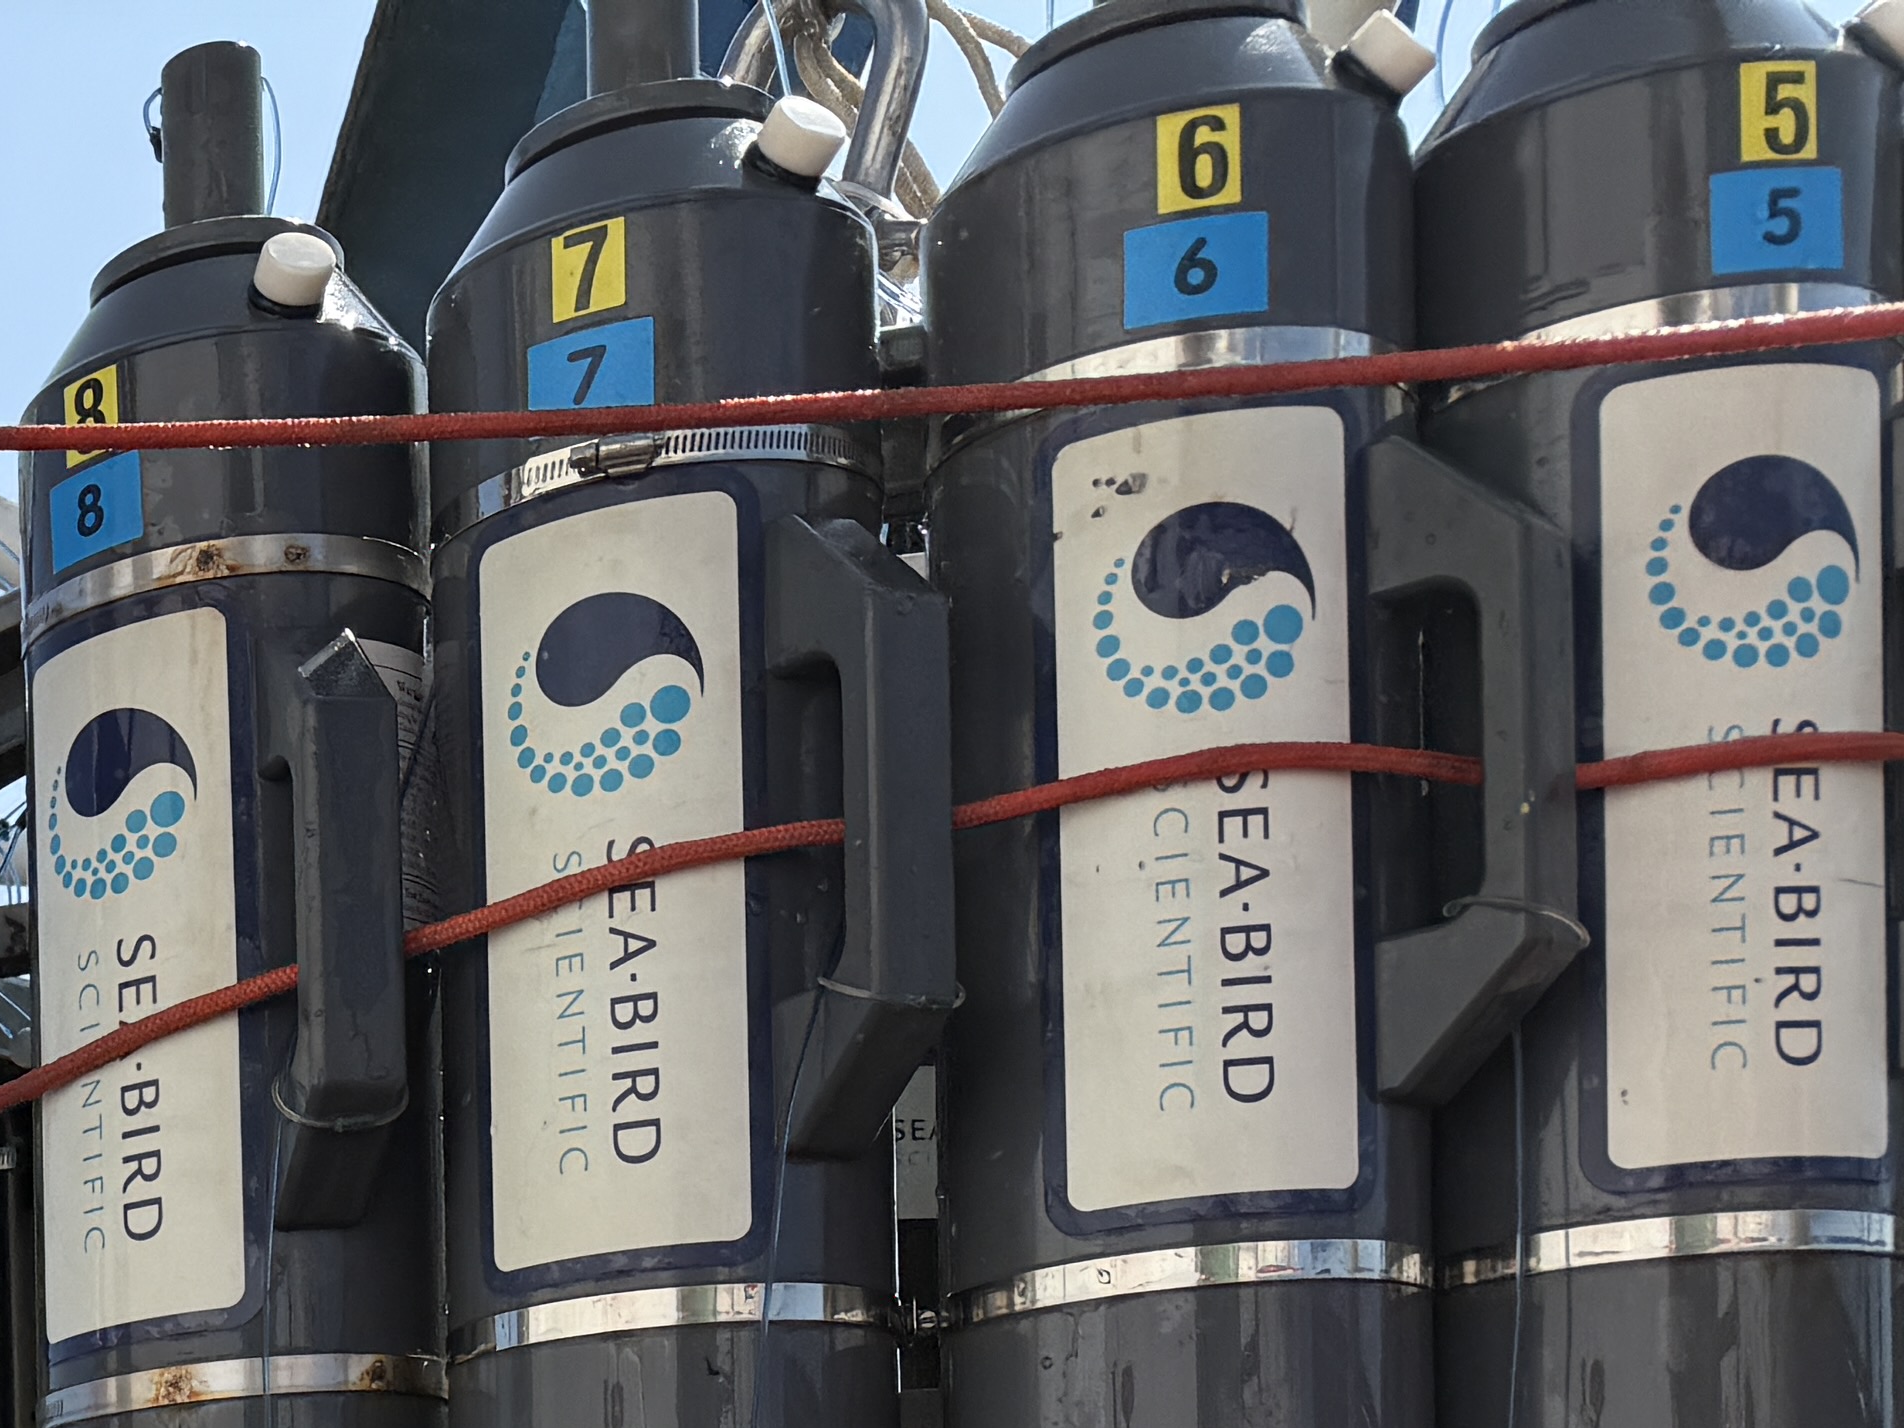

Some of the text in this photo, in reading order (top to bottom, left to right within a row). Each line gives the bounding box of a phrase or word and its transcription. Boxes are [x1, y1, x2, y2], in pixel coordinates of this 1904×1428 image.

[1177, 113, 1229, 200] 6
[1763, 72, 1810, 156] 5
[1762, 187, 1801, 246] 5
[563, 225, 608, 311] 7
[1173, 237, 1219, 296] 6
[567, 345, 606, 405] 7
[77, 483, 104, 538] 8
[1152, 780, 1195, 1112] CIENTIFIC
[552, 850, 589, 1175] SIENTIFIC
[76, 949, 107, 1255] SCINTIFIC
[115, 933, 164, 1243] SE·BIRD
